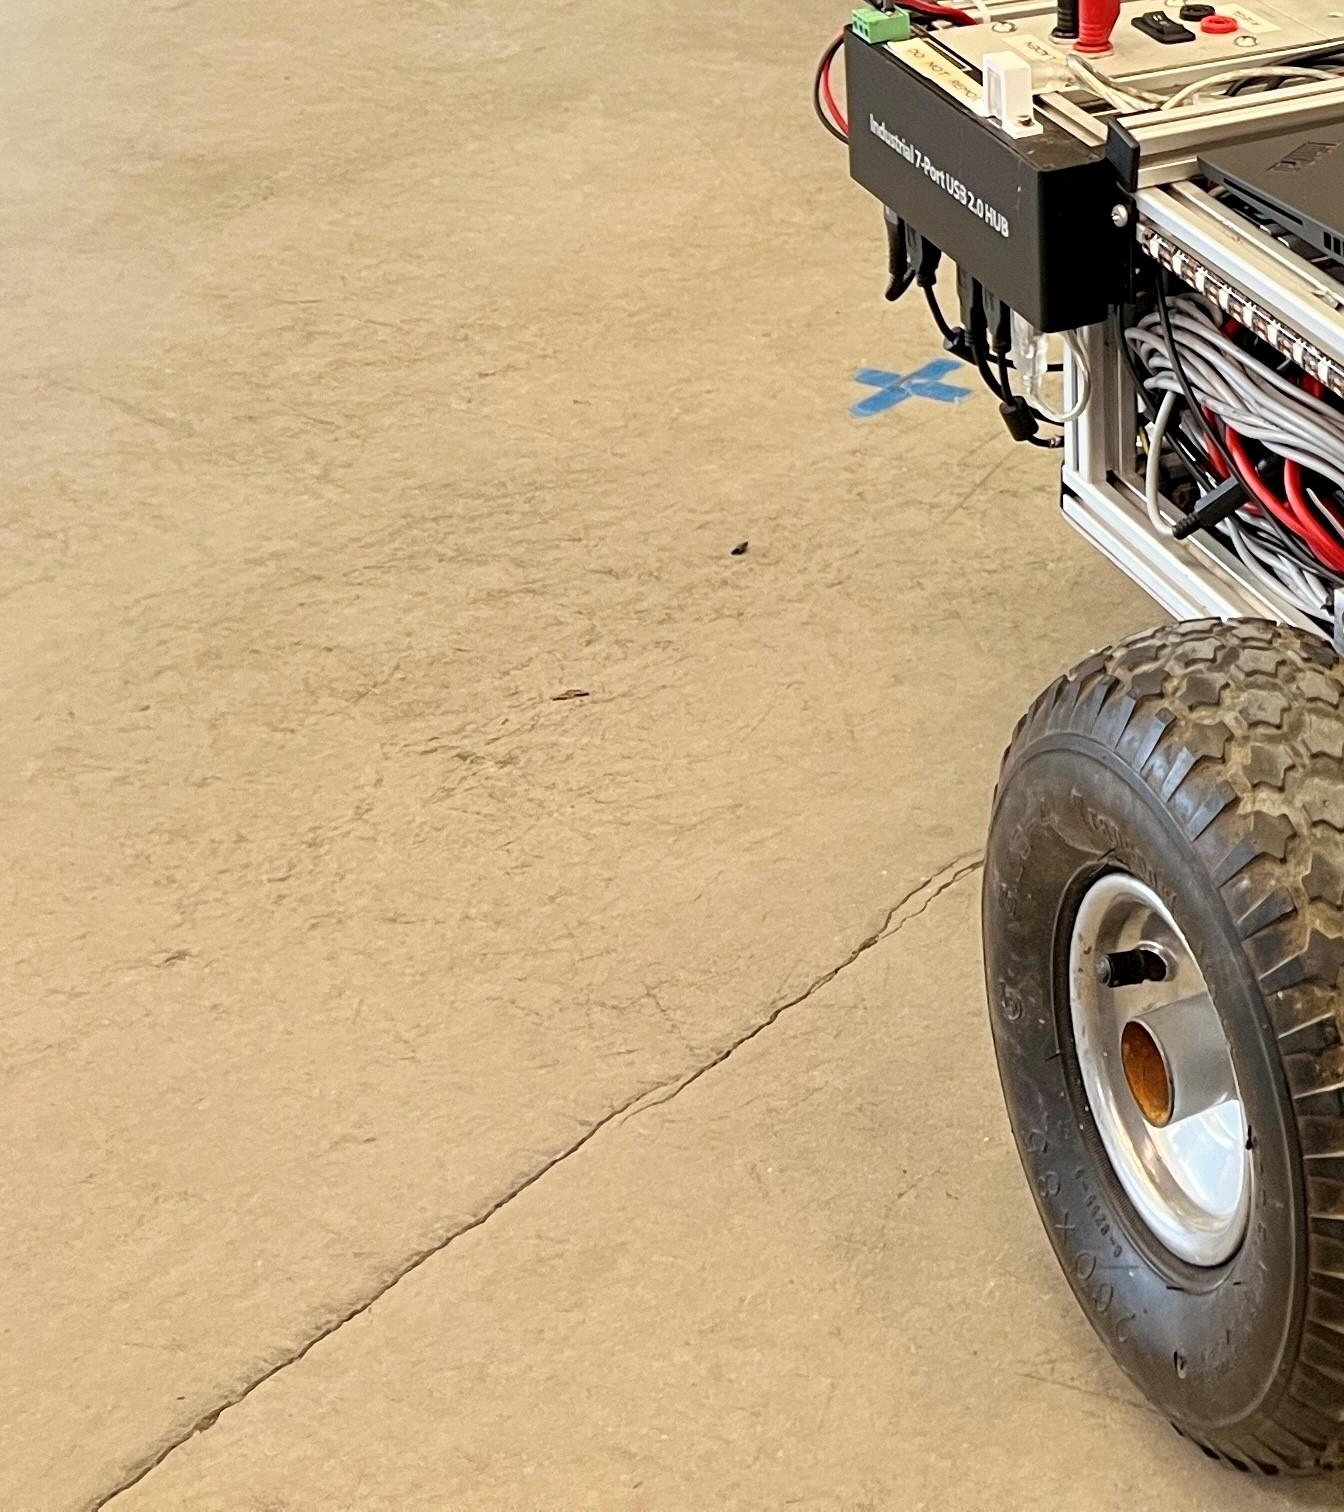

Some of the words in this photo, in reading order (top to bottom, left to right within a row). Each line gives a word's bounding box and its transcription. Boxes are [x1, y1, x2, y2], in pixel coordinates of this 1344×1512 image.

[868, 113, 915, 165] Industrial
[914, 149, 946, 189] 7-Port
[946, 174, 967, 207] USB
[967, 192, 985, 222] 2.0
[984, 207, 1010, 238] HUB
